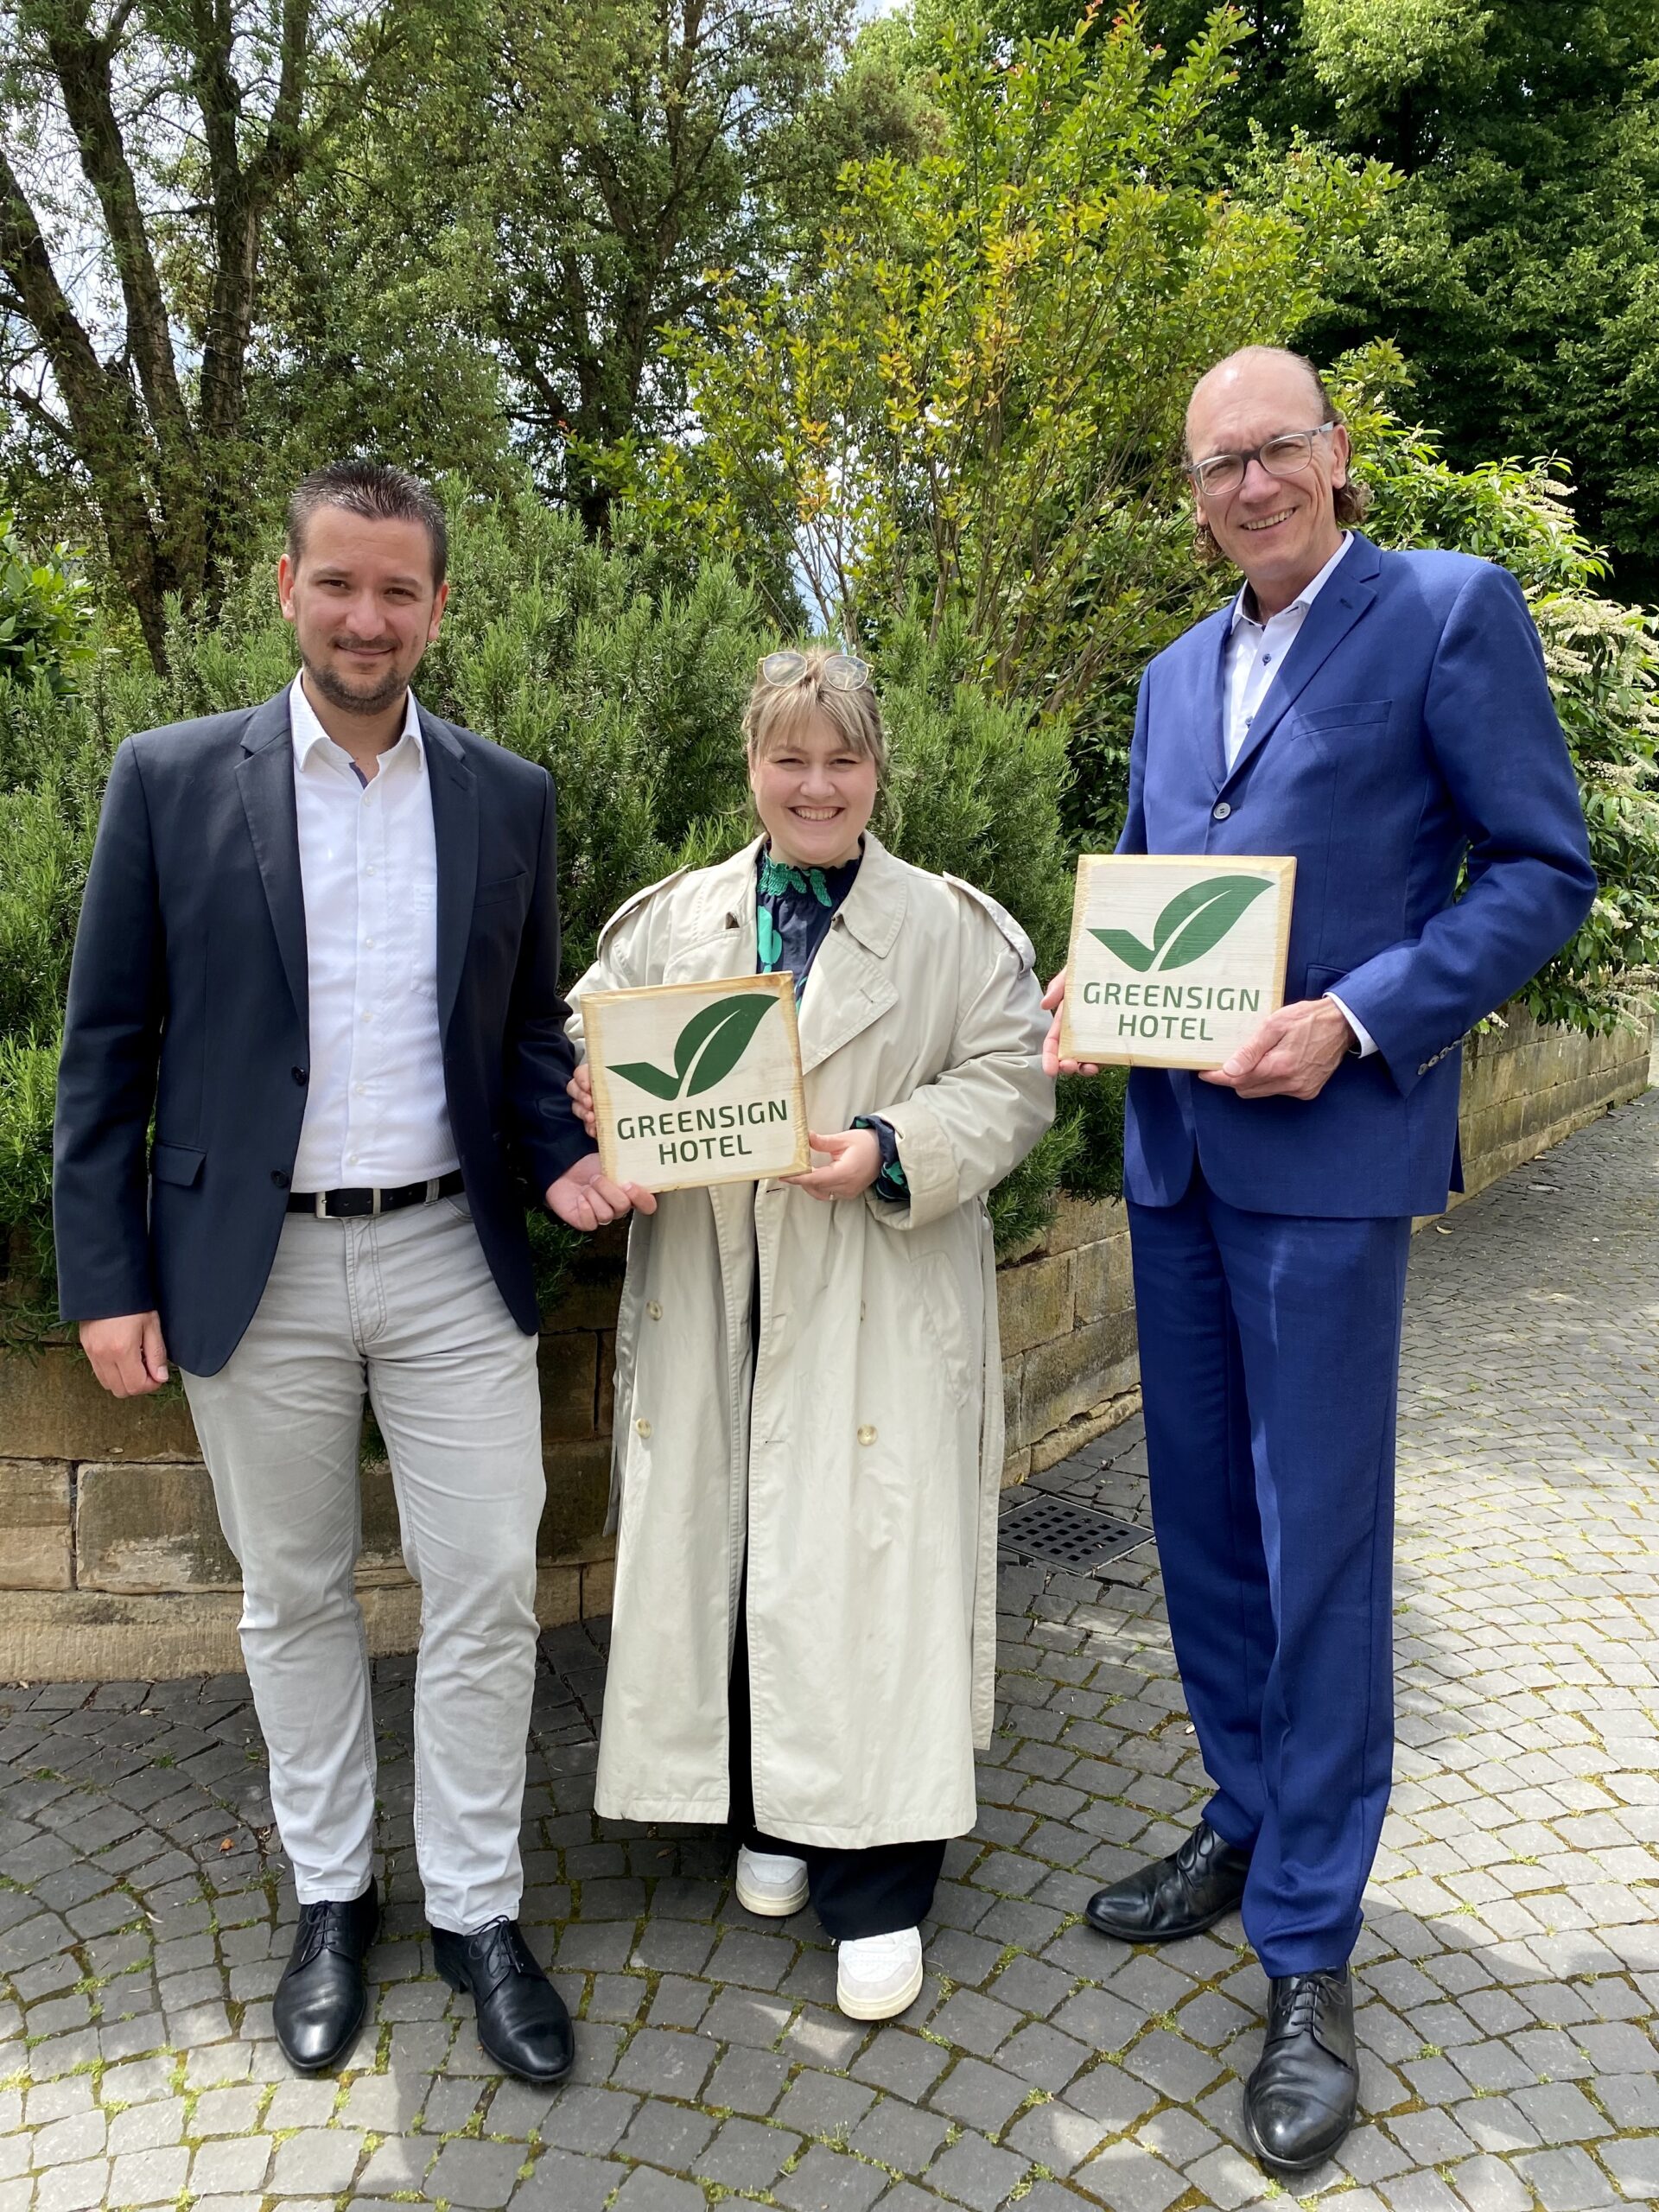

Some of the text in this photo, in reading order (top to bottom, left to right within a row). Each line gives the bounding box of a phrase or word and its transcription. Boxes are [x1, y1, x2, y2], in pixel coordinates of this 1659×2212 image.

[1083, 982, 1260, 1012] GREENSIGN
[1117, 1014, 1214, 1041] HOTEL
[616, 1099, 788, 1141] GREENSIGN
[658, 1135, 753, 1165] HOTEL
